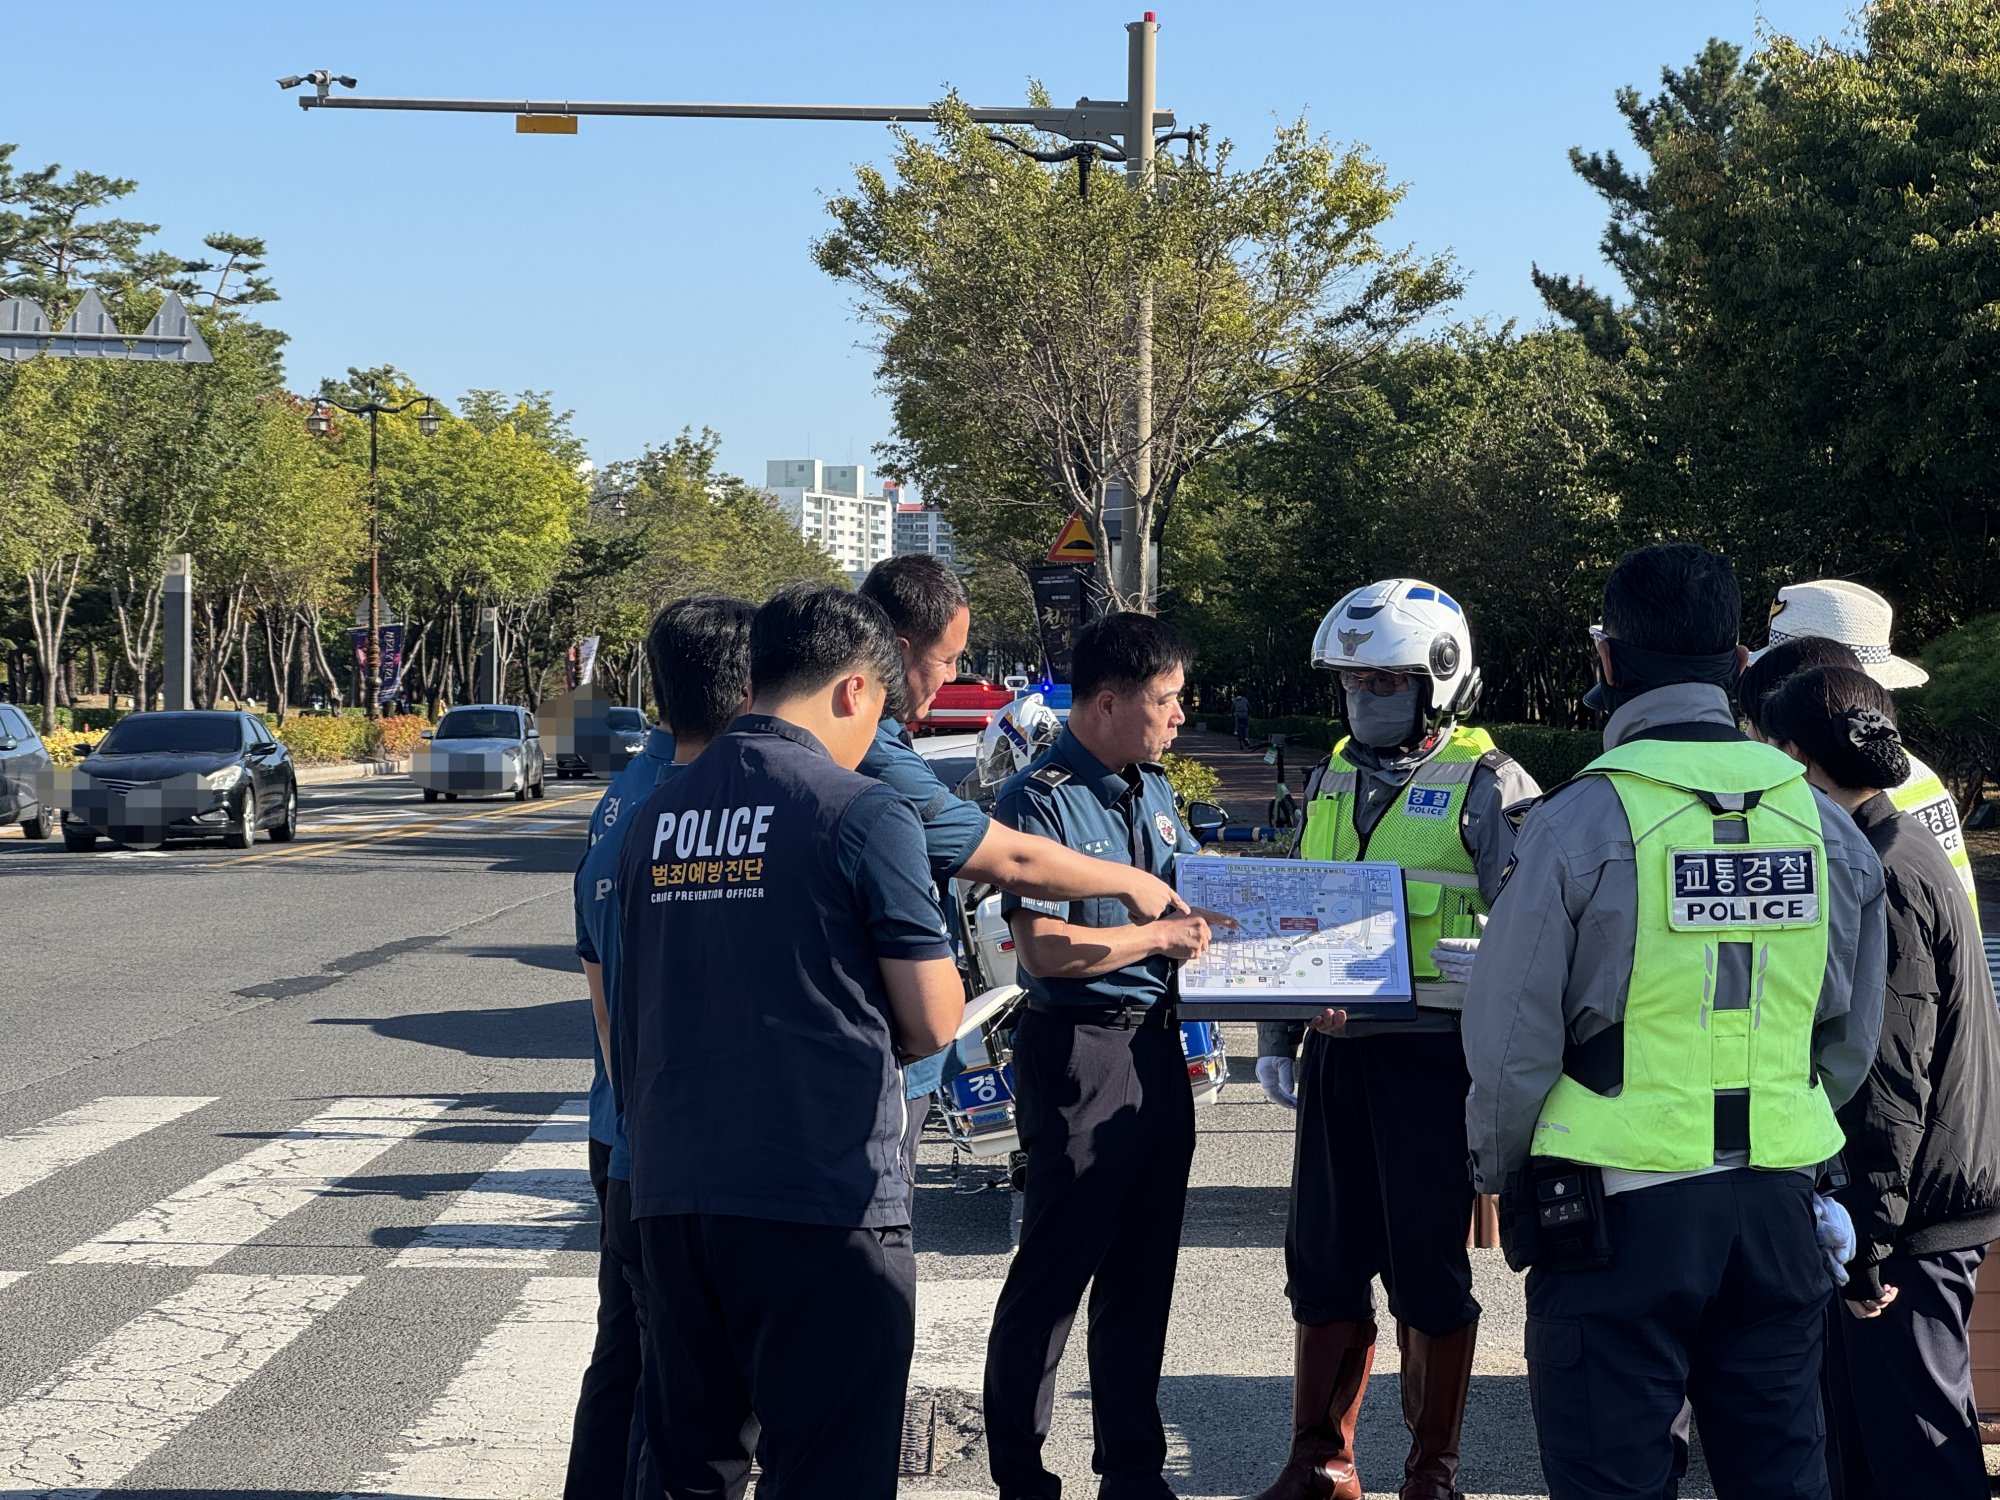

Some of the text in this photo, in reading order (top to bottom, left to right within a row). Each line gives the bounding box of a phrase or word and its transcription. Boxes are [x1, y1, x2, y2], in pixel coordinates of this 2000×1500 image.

[1409, 806, 1444, 816] POLICE
[1412, 790, 1447, 806] 경찰
[1913, 801, 1955, 833] 통경찰
[652, 806, 775, 860] POLICE
[651, 858, 764, 886] 범죄예방진단
[1683, 855, 1807, 894] 교통경찰
[651, 887, 764, 903] CRIME PREVENTION OFFICER
[1687, 900, 1804, 922] POLICE
[968, 1073, 997, 1102] 경
